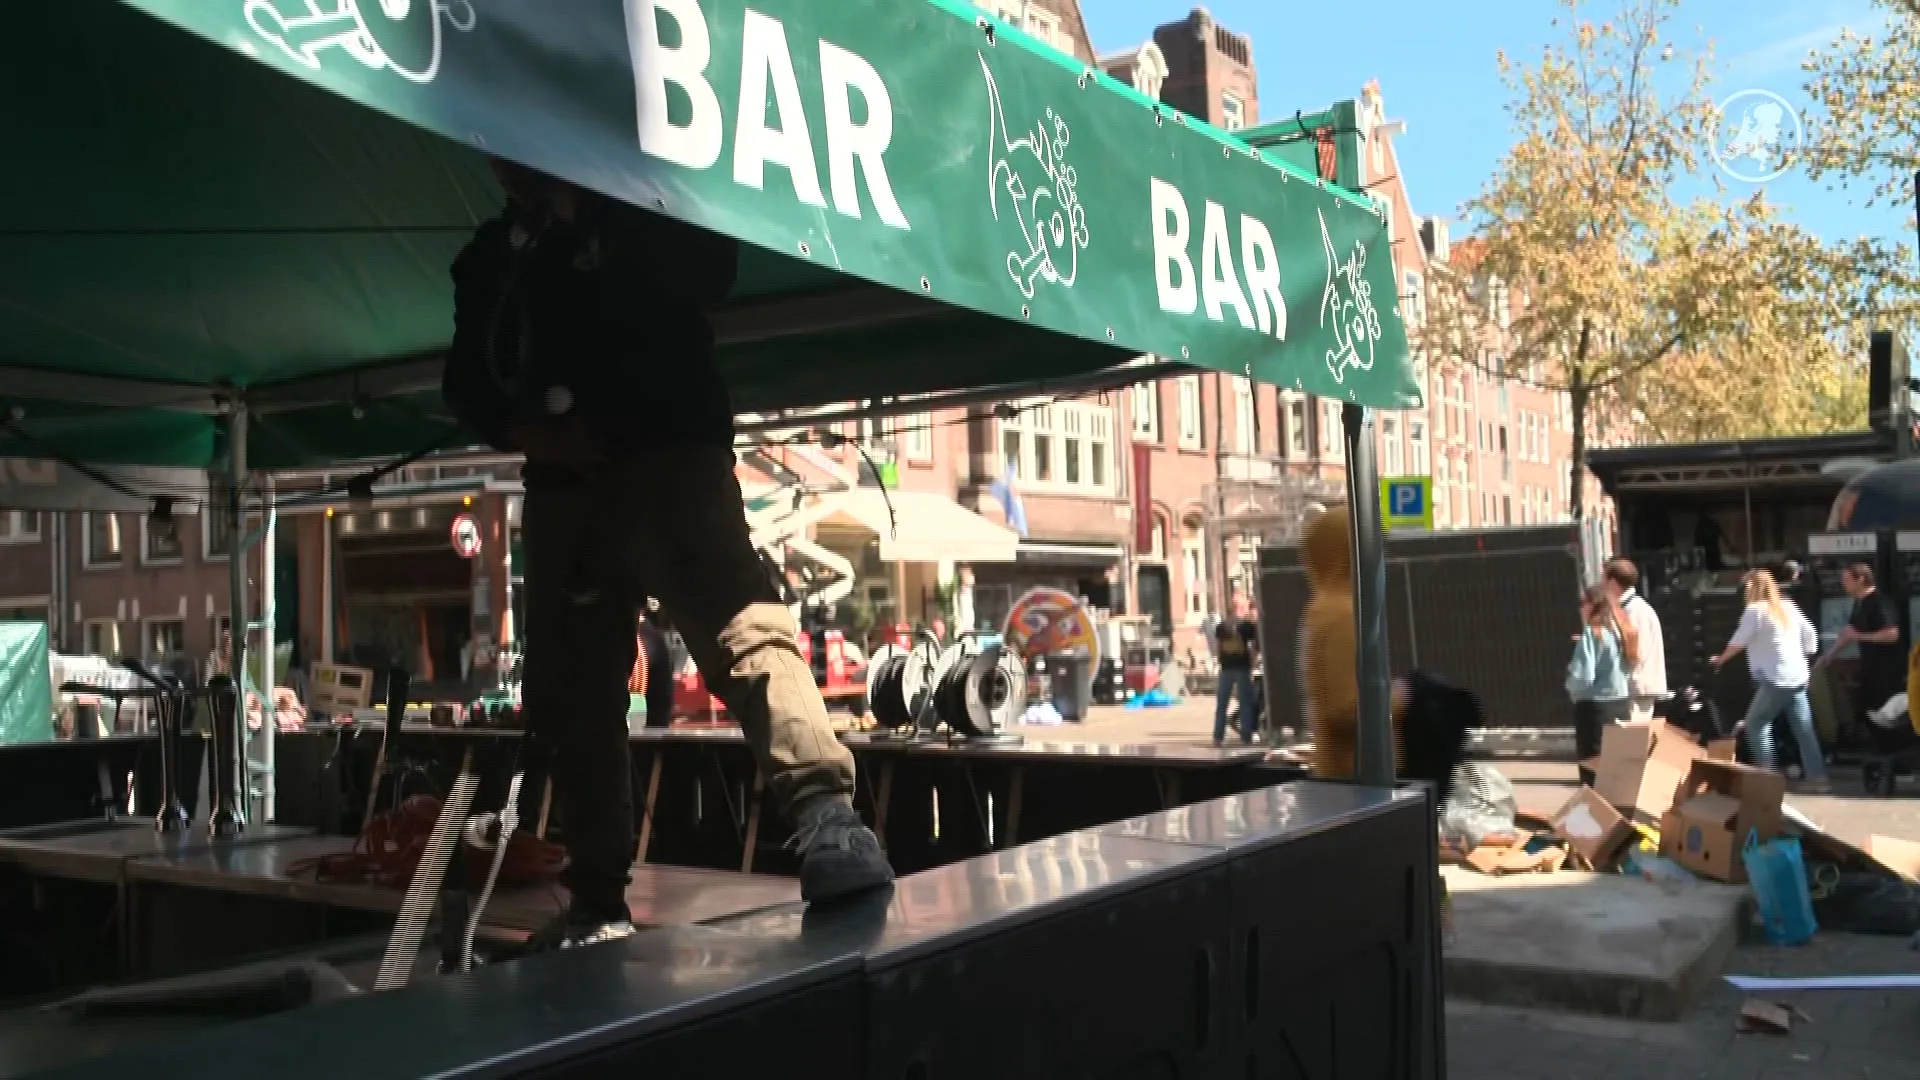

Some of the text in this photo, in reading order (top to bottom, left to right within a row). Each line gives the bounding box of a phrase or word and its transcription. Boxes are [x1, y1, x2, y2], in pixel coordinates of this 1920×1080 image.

[623, 0, 911, 230] BAR
[1150, 175, 1288, 342] BAR
[1396, 486, 1416, 513] P
